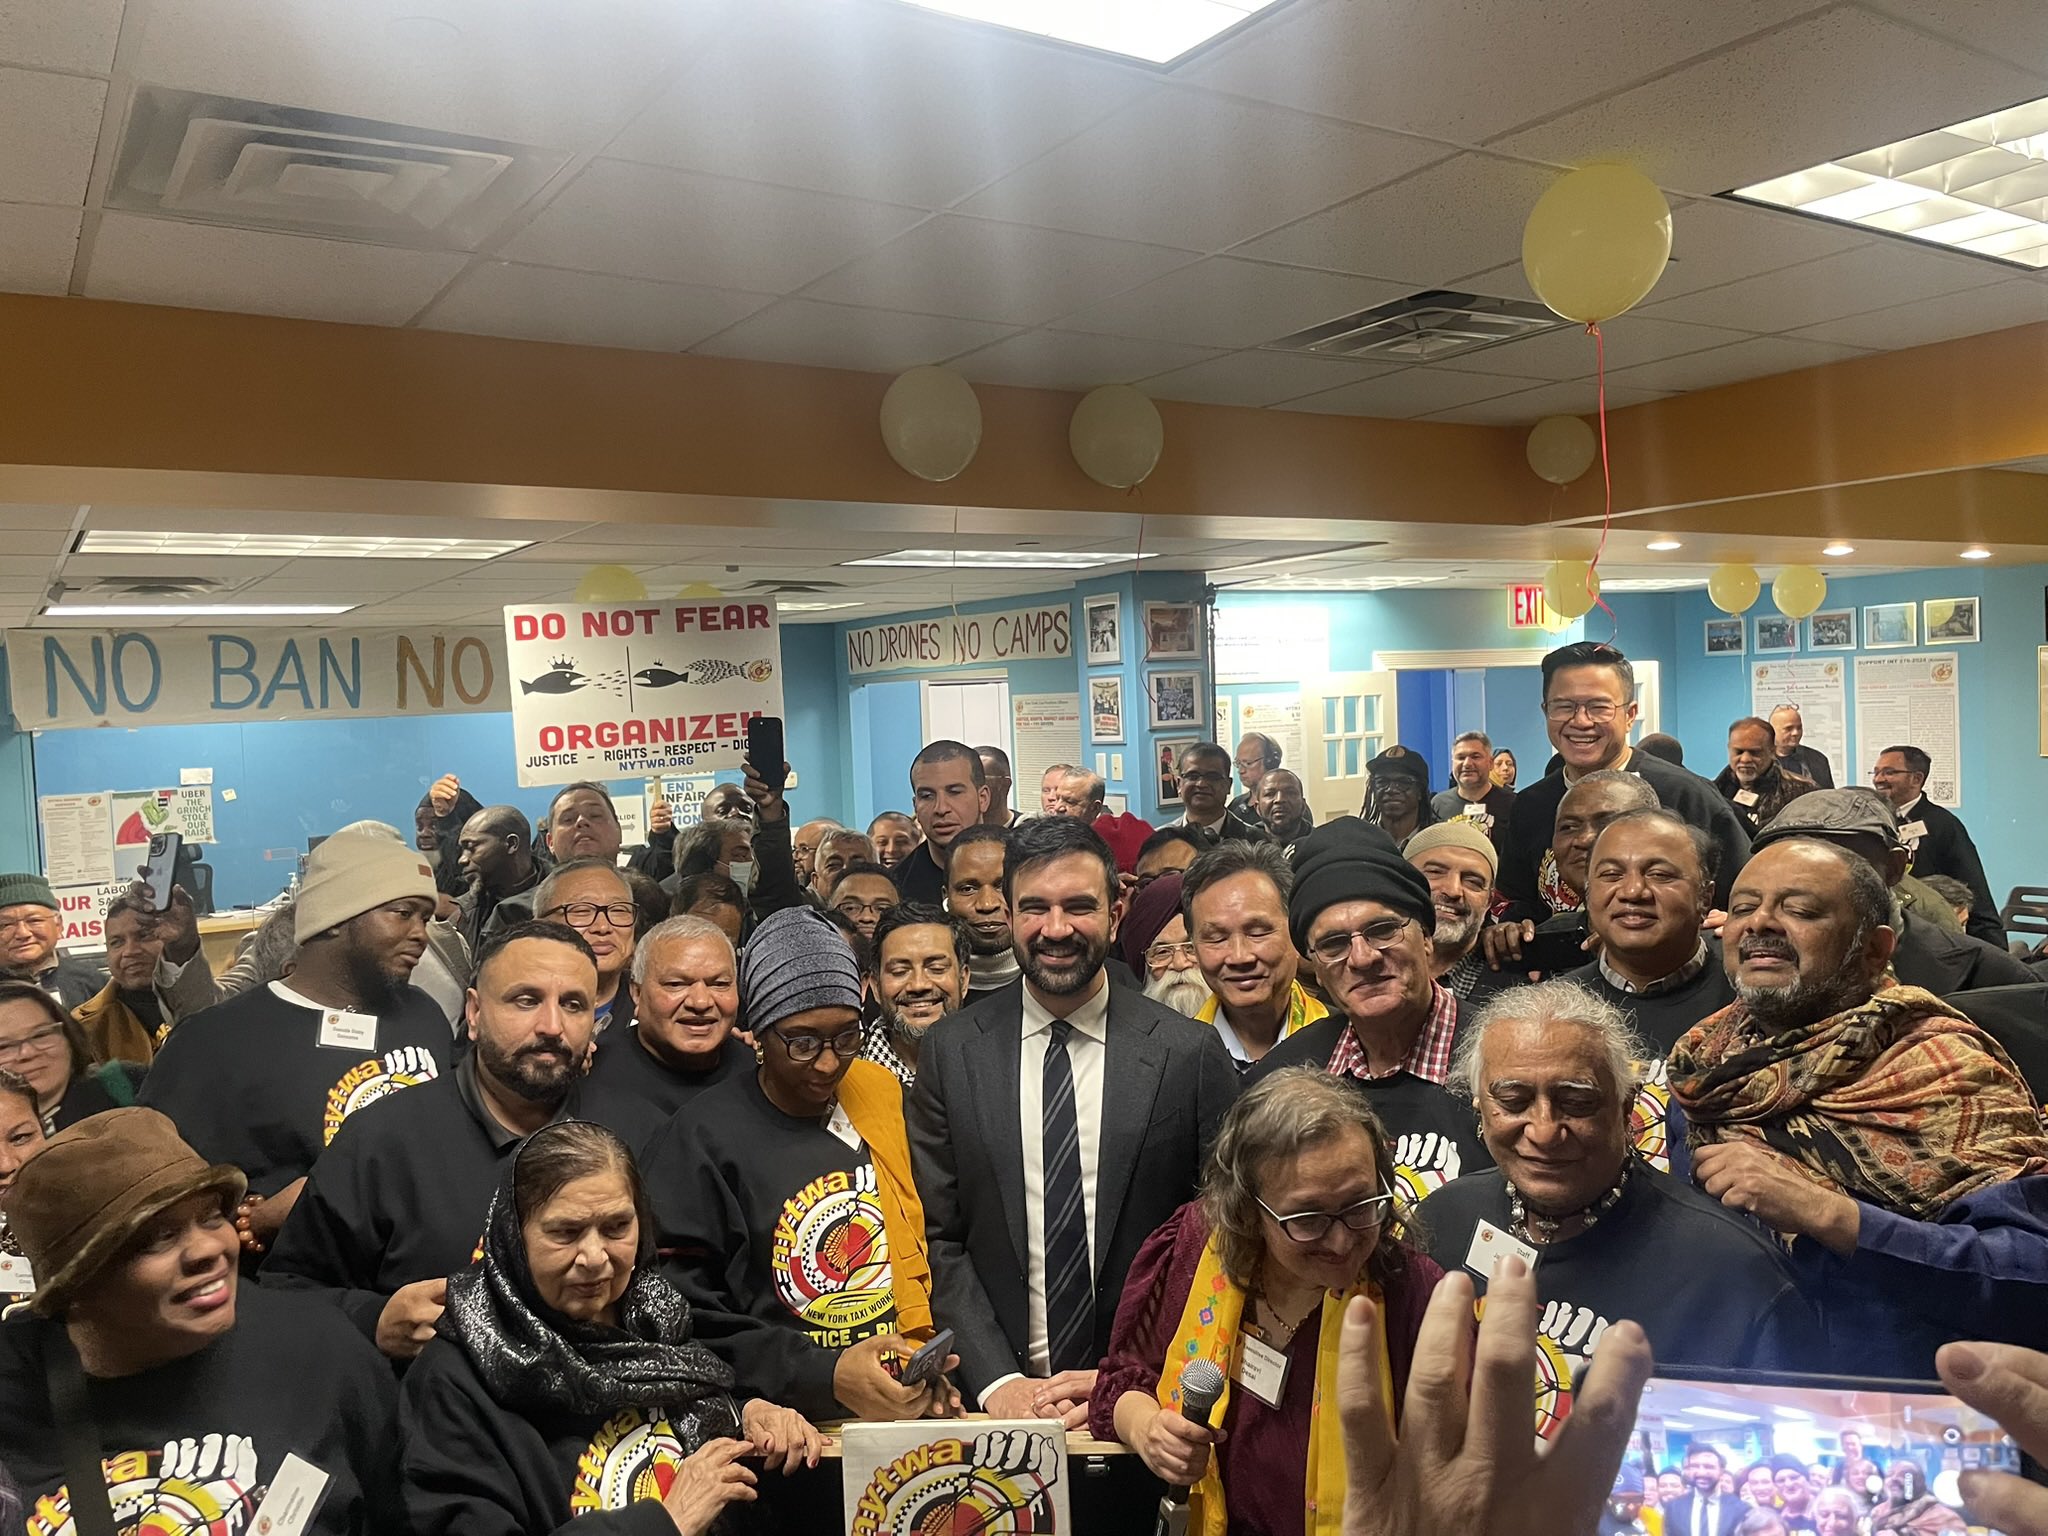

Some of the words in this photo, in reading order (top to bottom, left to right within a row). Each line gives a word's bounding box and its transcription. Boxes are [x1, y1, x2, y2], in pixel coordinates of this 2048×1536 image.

[1514, 587, 1545, 625] EXIT
[513, 613, 566, 641] DO
[582, 609, 661, 638] NOT
[675, 604, 771, 633] FEAR
[848, 630, 874, 671] NO
[879, 623, 941, 663] DRONES
[952, 621, 981, 665] NO
[992, 610, 1069, 657] CAMPS
[43, 632, 162, 718] NO
[208, 634, 361, 710] BAN
[396, 635, 494, 710] NO
[539, 711, 763, 753] ORGANIZE!
[525, 753, 578, 768] JUSTICE
[604, 747, 648, 762] RIGHTS
[664, 741, 717, 757] RESPECT
[733, 739, 750, 751] DIG
[619, 756, 694, 772] NYTWA.ORG
[181, 790, 206, 799] UBER
[667, 782, 694, 793] END
[177, 805, 211, 815] GRINCH
[186, 798, 203, 806] THE
[673, 803, 700, 814] ACT
[182, 813, 209, 822] STOLE
[187, 821, 207, 829] OUR
[184, 828, 211, 837] RAISE
[56, 895, 91, 911] UR
[58, 920, 103, 940] AIS
[771, 1170, 850, 1273] nytwa
[1516, 1246, 1532, 1260] Staff
[805, 1308, 826, 1321] NEW
[827, 1313, 848, 1324] YORK
[849, 1308, 868, 1322] TAXI
[868, 1288, 895, 1314] WORKE
[808, 1328, 852, 1348] TICE
[570, 1406, 643, 1512] ytwa
